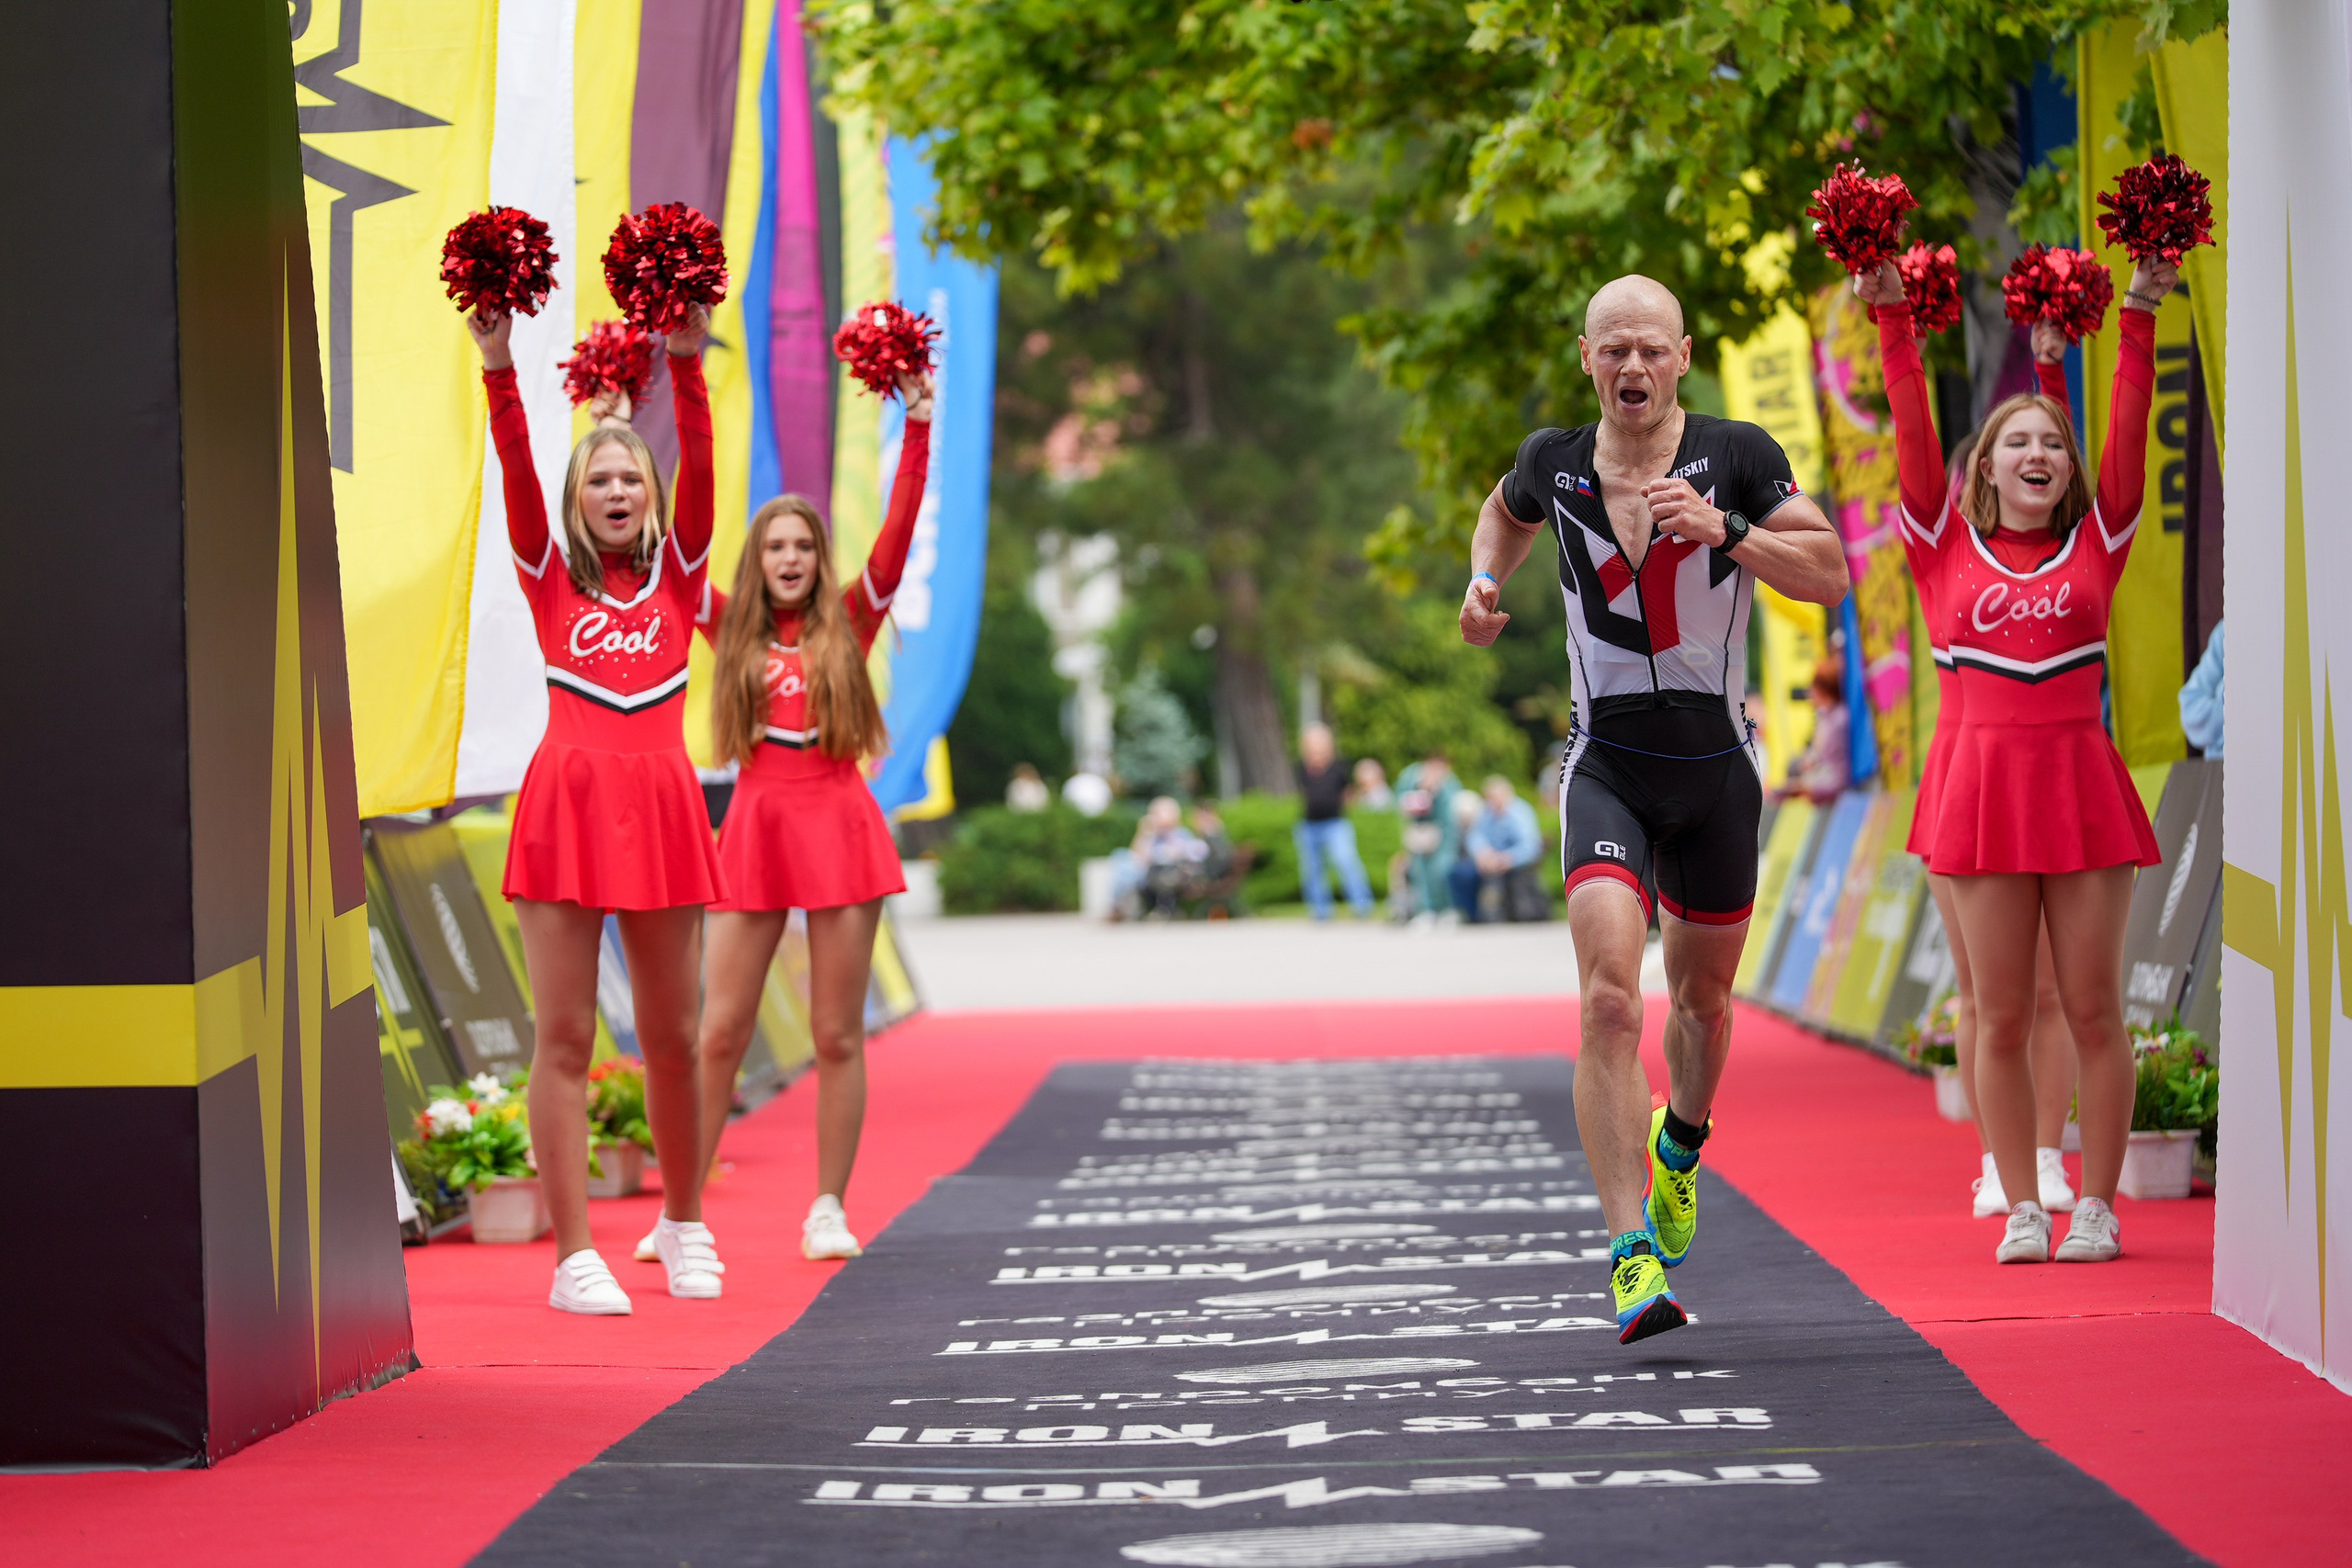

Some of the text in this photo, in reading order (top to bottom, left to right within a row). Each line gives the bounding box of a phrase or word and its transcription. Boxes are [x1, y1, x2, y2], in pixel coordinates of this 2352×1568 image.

[1972, 581, 2072, 633] Cool
[570, 612, 662, 658] Cool
[1611, 1232, 1655, 1255] PRESS
[995, 1262, 1247, 1280] IRON
[944, 1314, 1698, 1353] IRON STA
[864, 1408, 1772, 1443] IRON STAR
[814, 1463, 1821, 1502] IRON STAR
